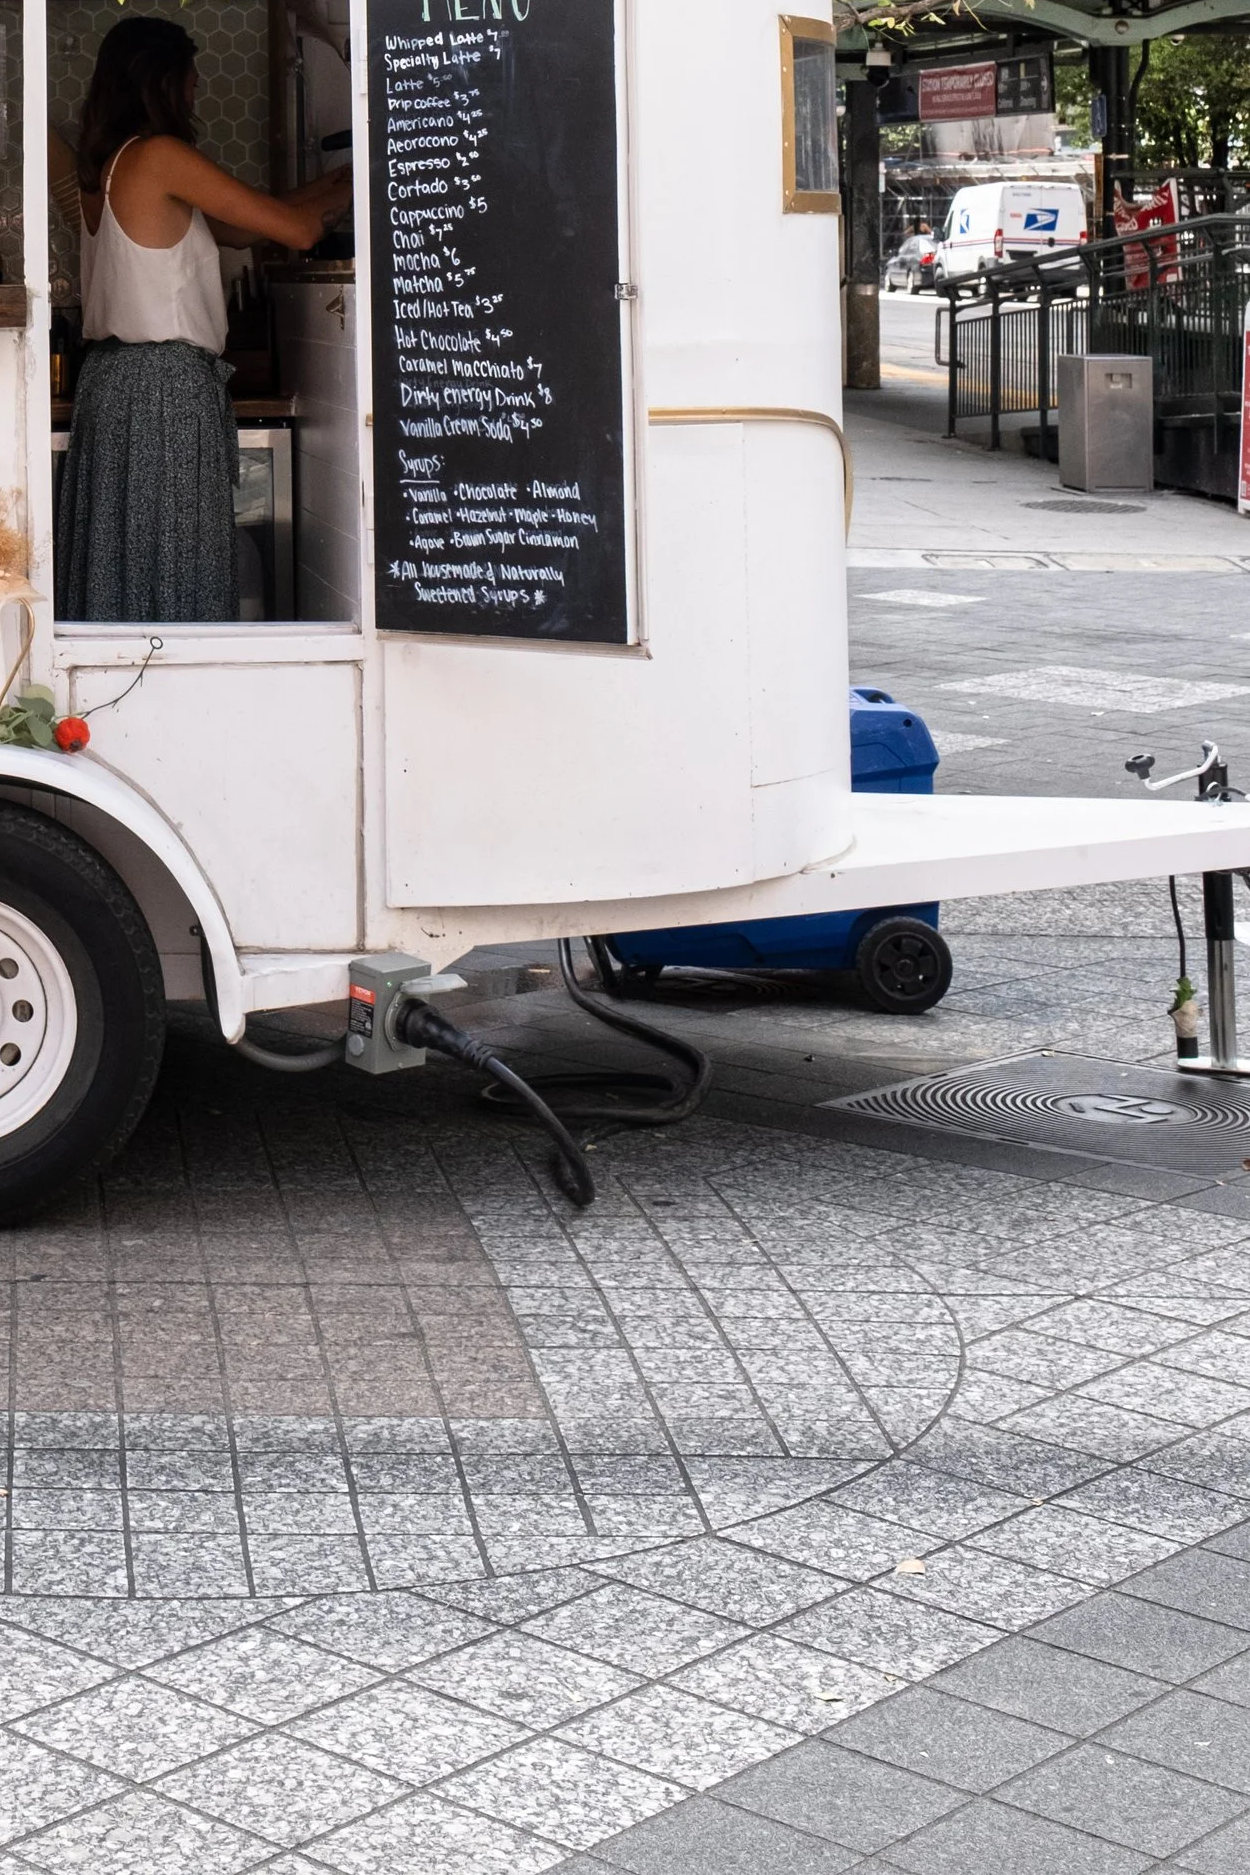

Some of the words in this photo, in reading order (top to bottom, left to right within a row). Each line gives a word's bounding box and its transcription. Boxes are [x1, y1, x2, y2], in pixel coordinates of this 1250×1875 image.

[385, 32, 443, 50] Whipped
[450, 33, 483, 46] Latte
[384, 53, 439, 73] Specialty
[443, 51, 481, 65] Latte
[489, 45, 500, 60] $7
[386, 78, 424, 94] Latte
[388, 98, 412, 111] Drip
[414, 96, 451, 109] coffee
[388, 116, 453, 133] Americano
[389, 158, 450, 177] Espresso
[388, 177, 448, 201] Cortado
[390, 205, 464, 228] Cappuccino
[469, 196, 488, 213] $5
[393, 230, 424, 249] Chai
[443, 246, 460, 266] $6
[393, 275, 443, 294] Matcha
[451, 301, 474, 318] Tea
[395, 325, 417, 349] Hot
[420, 329, 481, 354] Chocolate
[399, 355, 447, 374] Caramel
[527, 356, 542, 379] $7
[401, 383, 440, 411] Dirty
[495, 387, 535, 408] Drink
[537, 383, 552, 405] $8
[400, 418, 443, 438] Vanilla
[443, 415, 481, 437] Cream
[482, 417, 513, 444] Soda
[398, 449, 446, 479] Syrups:
[409, 488, 447, 503] Vanilla
[459, 482, 517, 501] Chocolate
[532, 480, 581, 501] Almond
[413, 507, 451, 524] Caramel
[460, 507, 507, 523] Hazelnut
[557, 508, 598, 533] Honey
[415, 536, 444, 554] Agave
[454, 531, 486, 548] Brown
[486, 529, 515, 553] Sugar
[518, 528, 580, 550] Cinnamon
[500, 564, 565, 587] Naturally
[415, 581, 476, 603] Sweetened
[481, 586, 530, 608] Syrups
